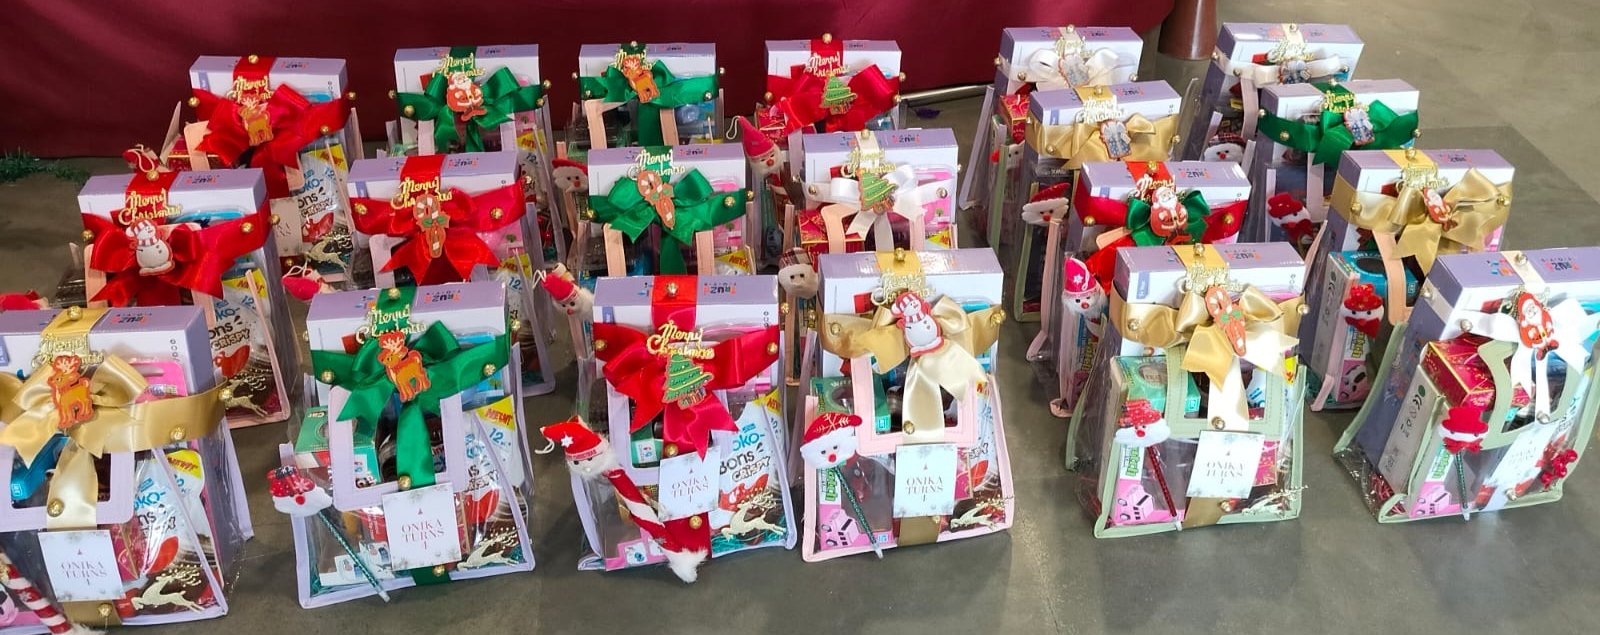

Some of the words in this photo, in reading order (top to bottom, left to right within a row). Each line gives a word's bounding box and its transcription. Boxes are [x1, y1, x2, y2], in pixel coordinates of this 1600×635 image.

[635, 149, 673, 168] Merry
[399, 176, 440, 193] Merry
[126, 188, 167, 209] Merry
[366, 304, 411, 325] Merry
[658, 320, 703, 342] Merry
[647, 334, 715, 359] Christmas
[671, 475, 708, 489] ONIKA
[906, 475, 943, 486] ONIKA
[672, 483, 709, 498] TURNS
[906, 485, 944, 495] TURNS
[402, 519, 443, 534] ONIKA
[403, 528, 445, 543] TURNS
[61, 560, 105, 571] ONIKA
[65, 569, 108, 580] TURNS
